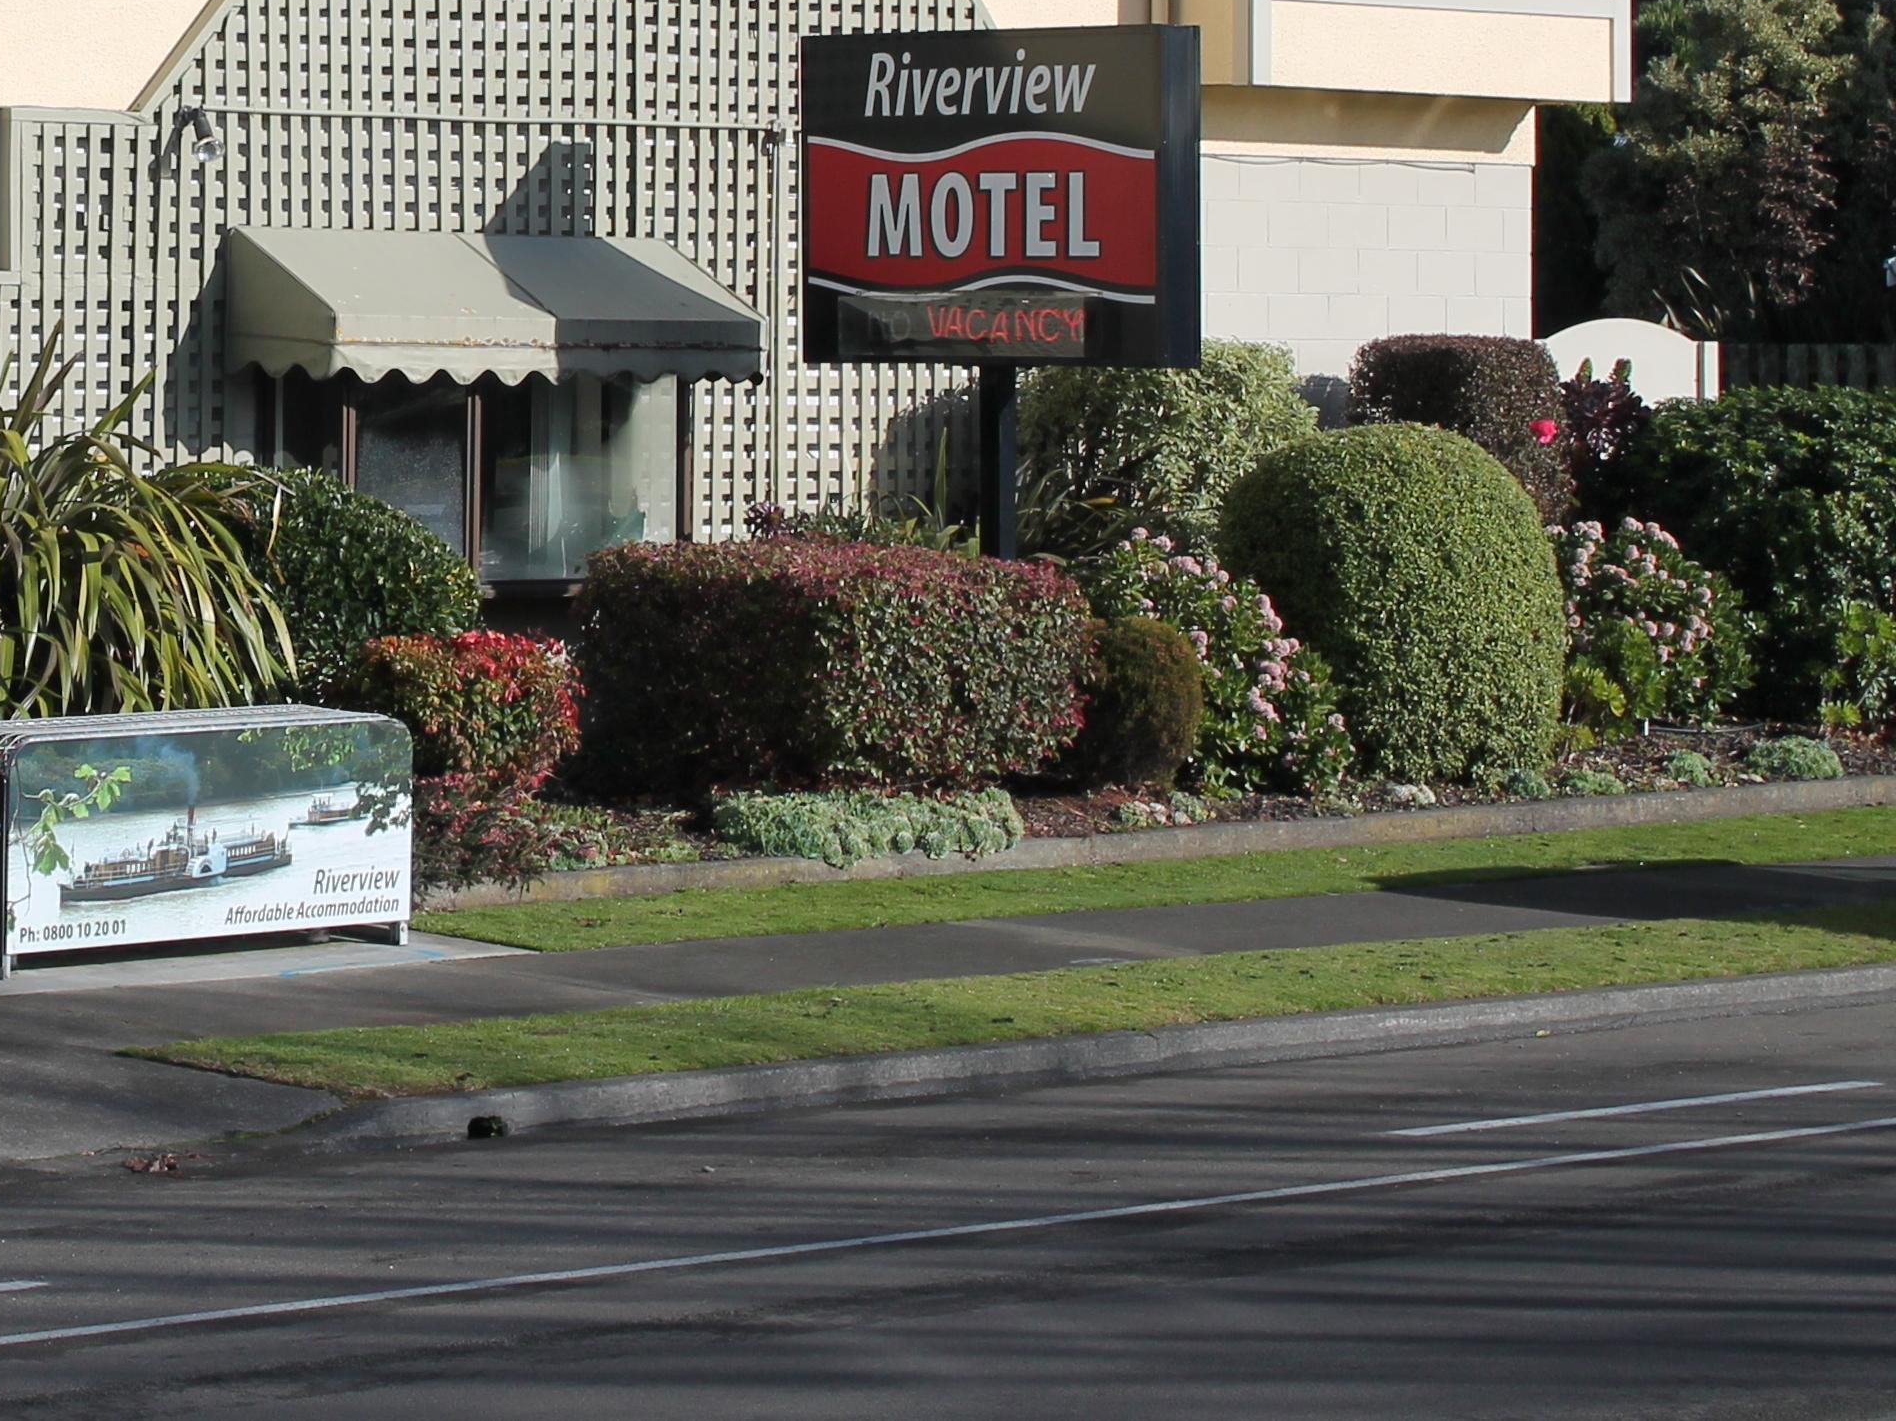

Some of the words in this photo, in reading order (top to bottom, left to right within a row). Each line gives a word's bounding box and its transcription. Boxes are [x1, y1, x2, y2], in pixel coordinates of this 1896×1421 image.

[864, 48, 1097, 118] Riverview
[866, 171, 1101, 259] MOTEL
[927, 305, 1086, 343] VACANCY
[313, 865, 400, 894] Riverview
[224, 902, 294, 925] Affordable
[296, 895, 400, 920] Accommodation
[20, 926, 40, 943] Ph:
[43, 924, 73, 941] 0800
[77, 922, 91, 938] 10
[94, 920, 109, 937] 20
[112, 918, 126, 935] 01
